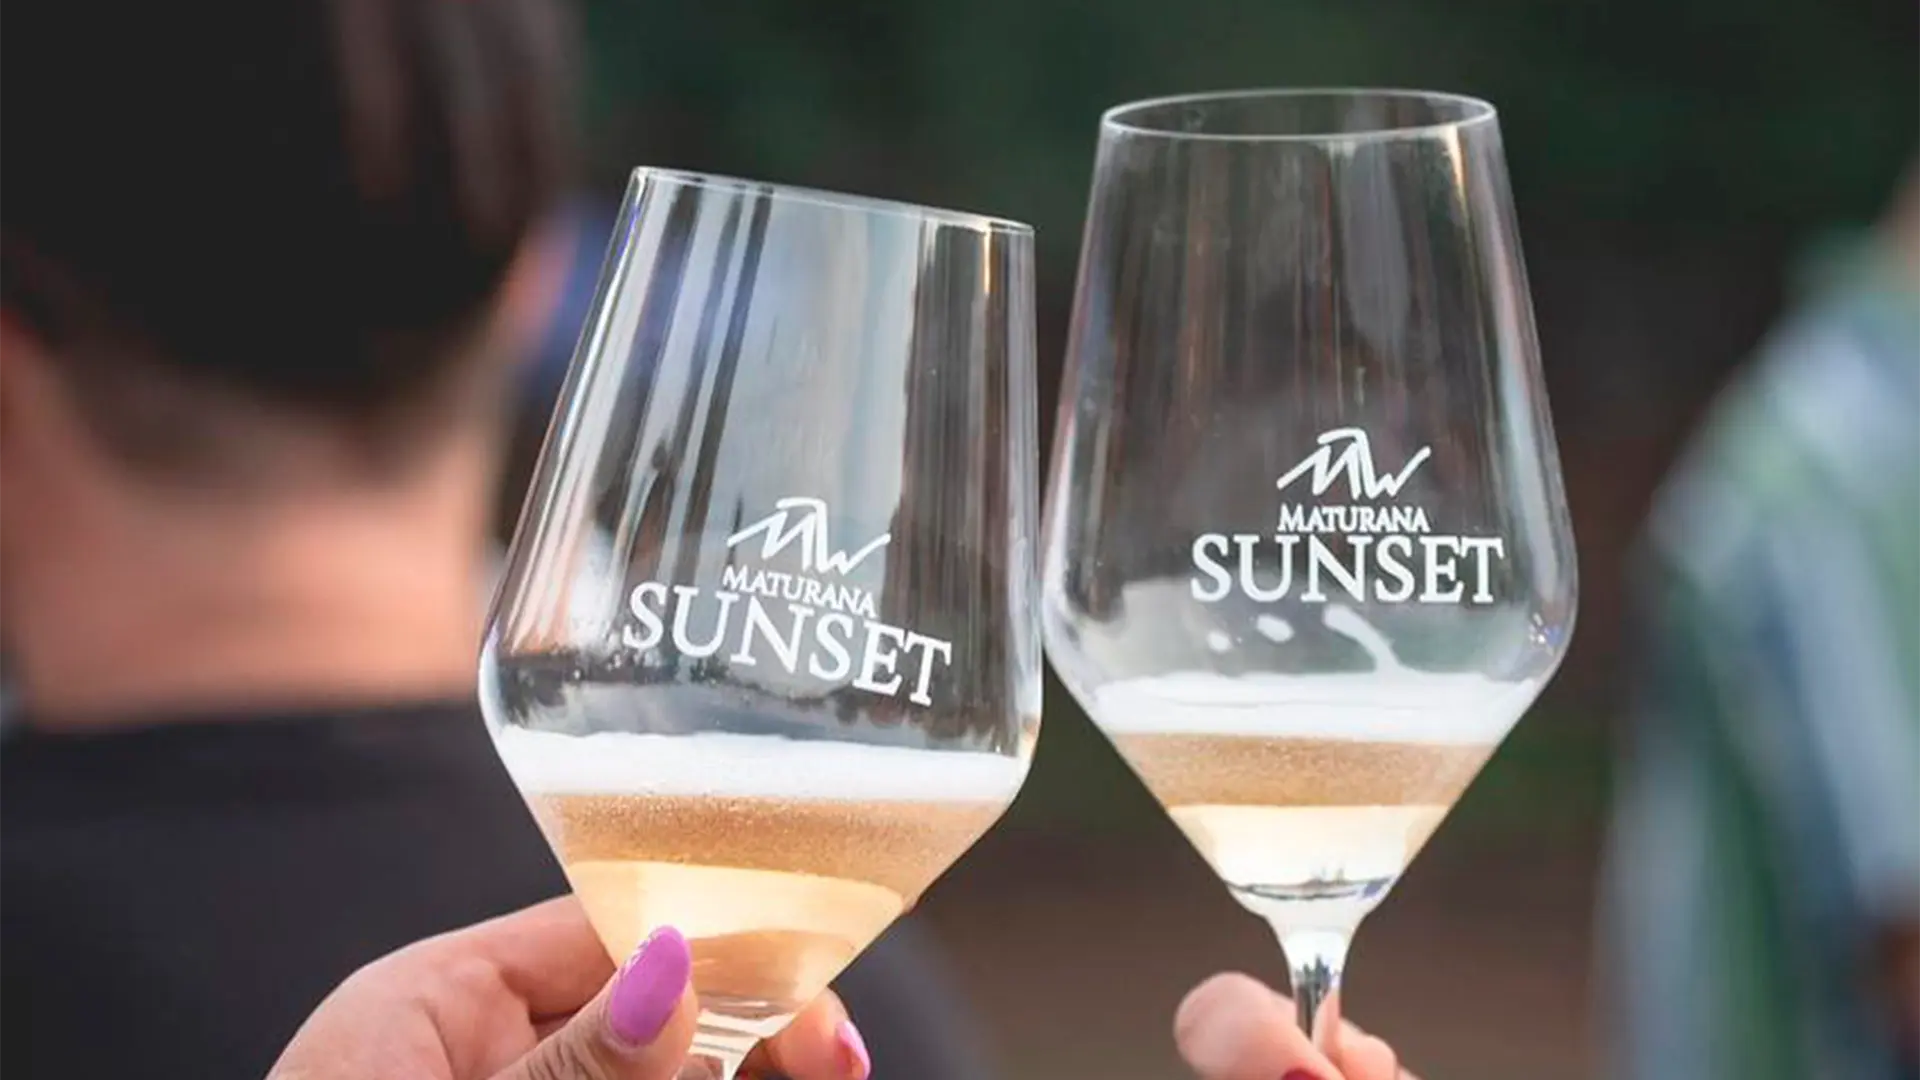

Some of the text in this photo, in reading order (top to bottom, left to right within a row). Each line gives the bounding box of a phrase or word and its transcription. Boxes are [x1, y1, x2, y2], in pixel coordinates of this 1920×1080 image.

[1277, 504, 1431, 533] MATURANA
[722, 565, 878, 618] MATURANA
[1190, 533, 1505, 604] SUNSET
[622, 582, 952, 708] SUNSET
